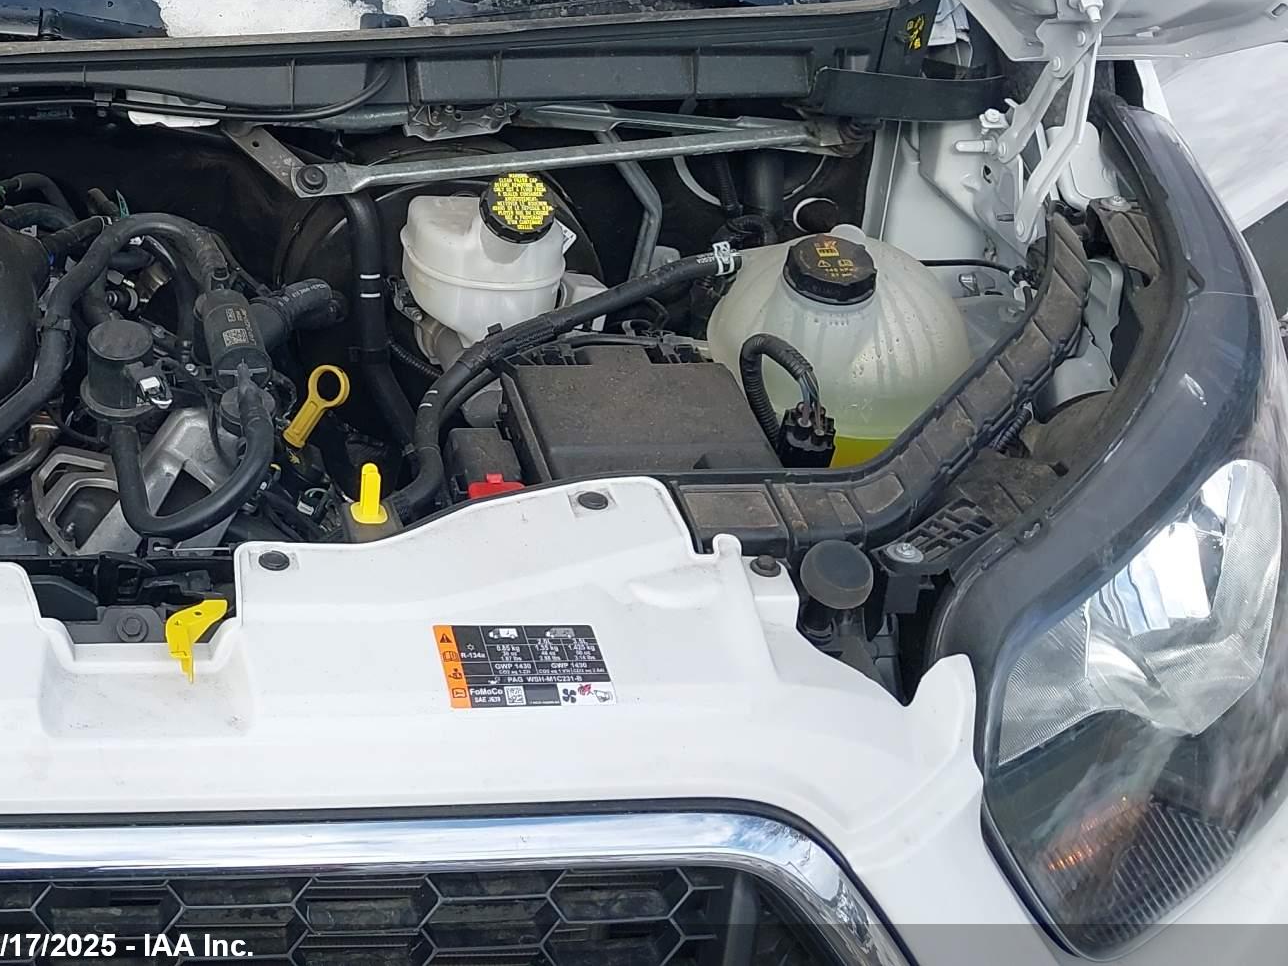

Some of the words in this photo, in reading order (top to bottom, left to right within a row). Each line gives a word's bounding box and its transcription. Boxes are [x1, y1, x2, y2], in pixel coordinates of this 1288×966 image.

[511, 644, 520, 653] kg
[550, 644, 559, 652] kg
[507, 675, 523, 683] PAG
